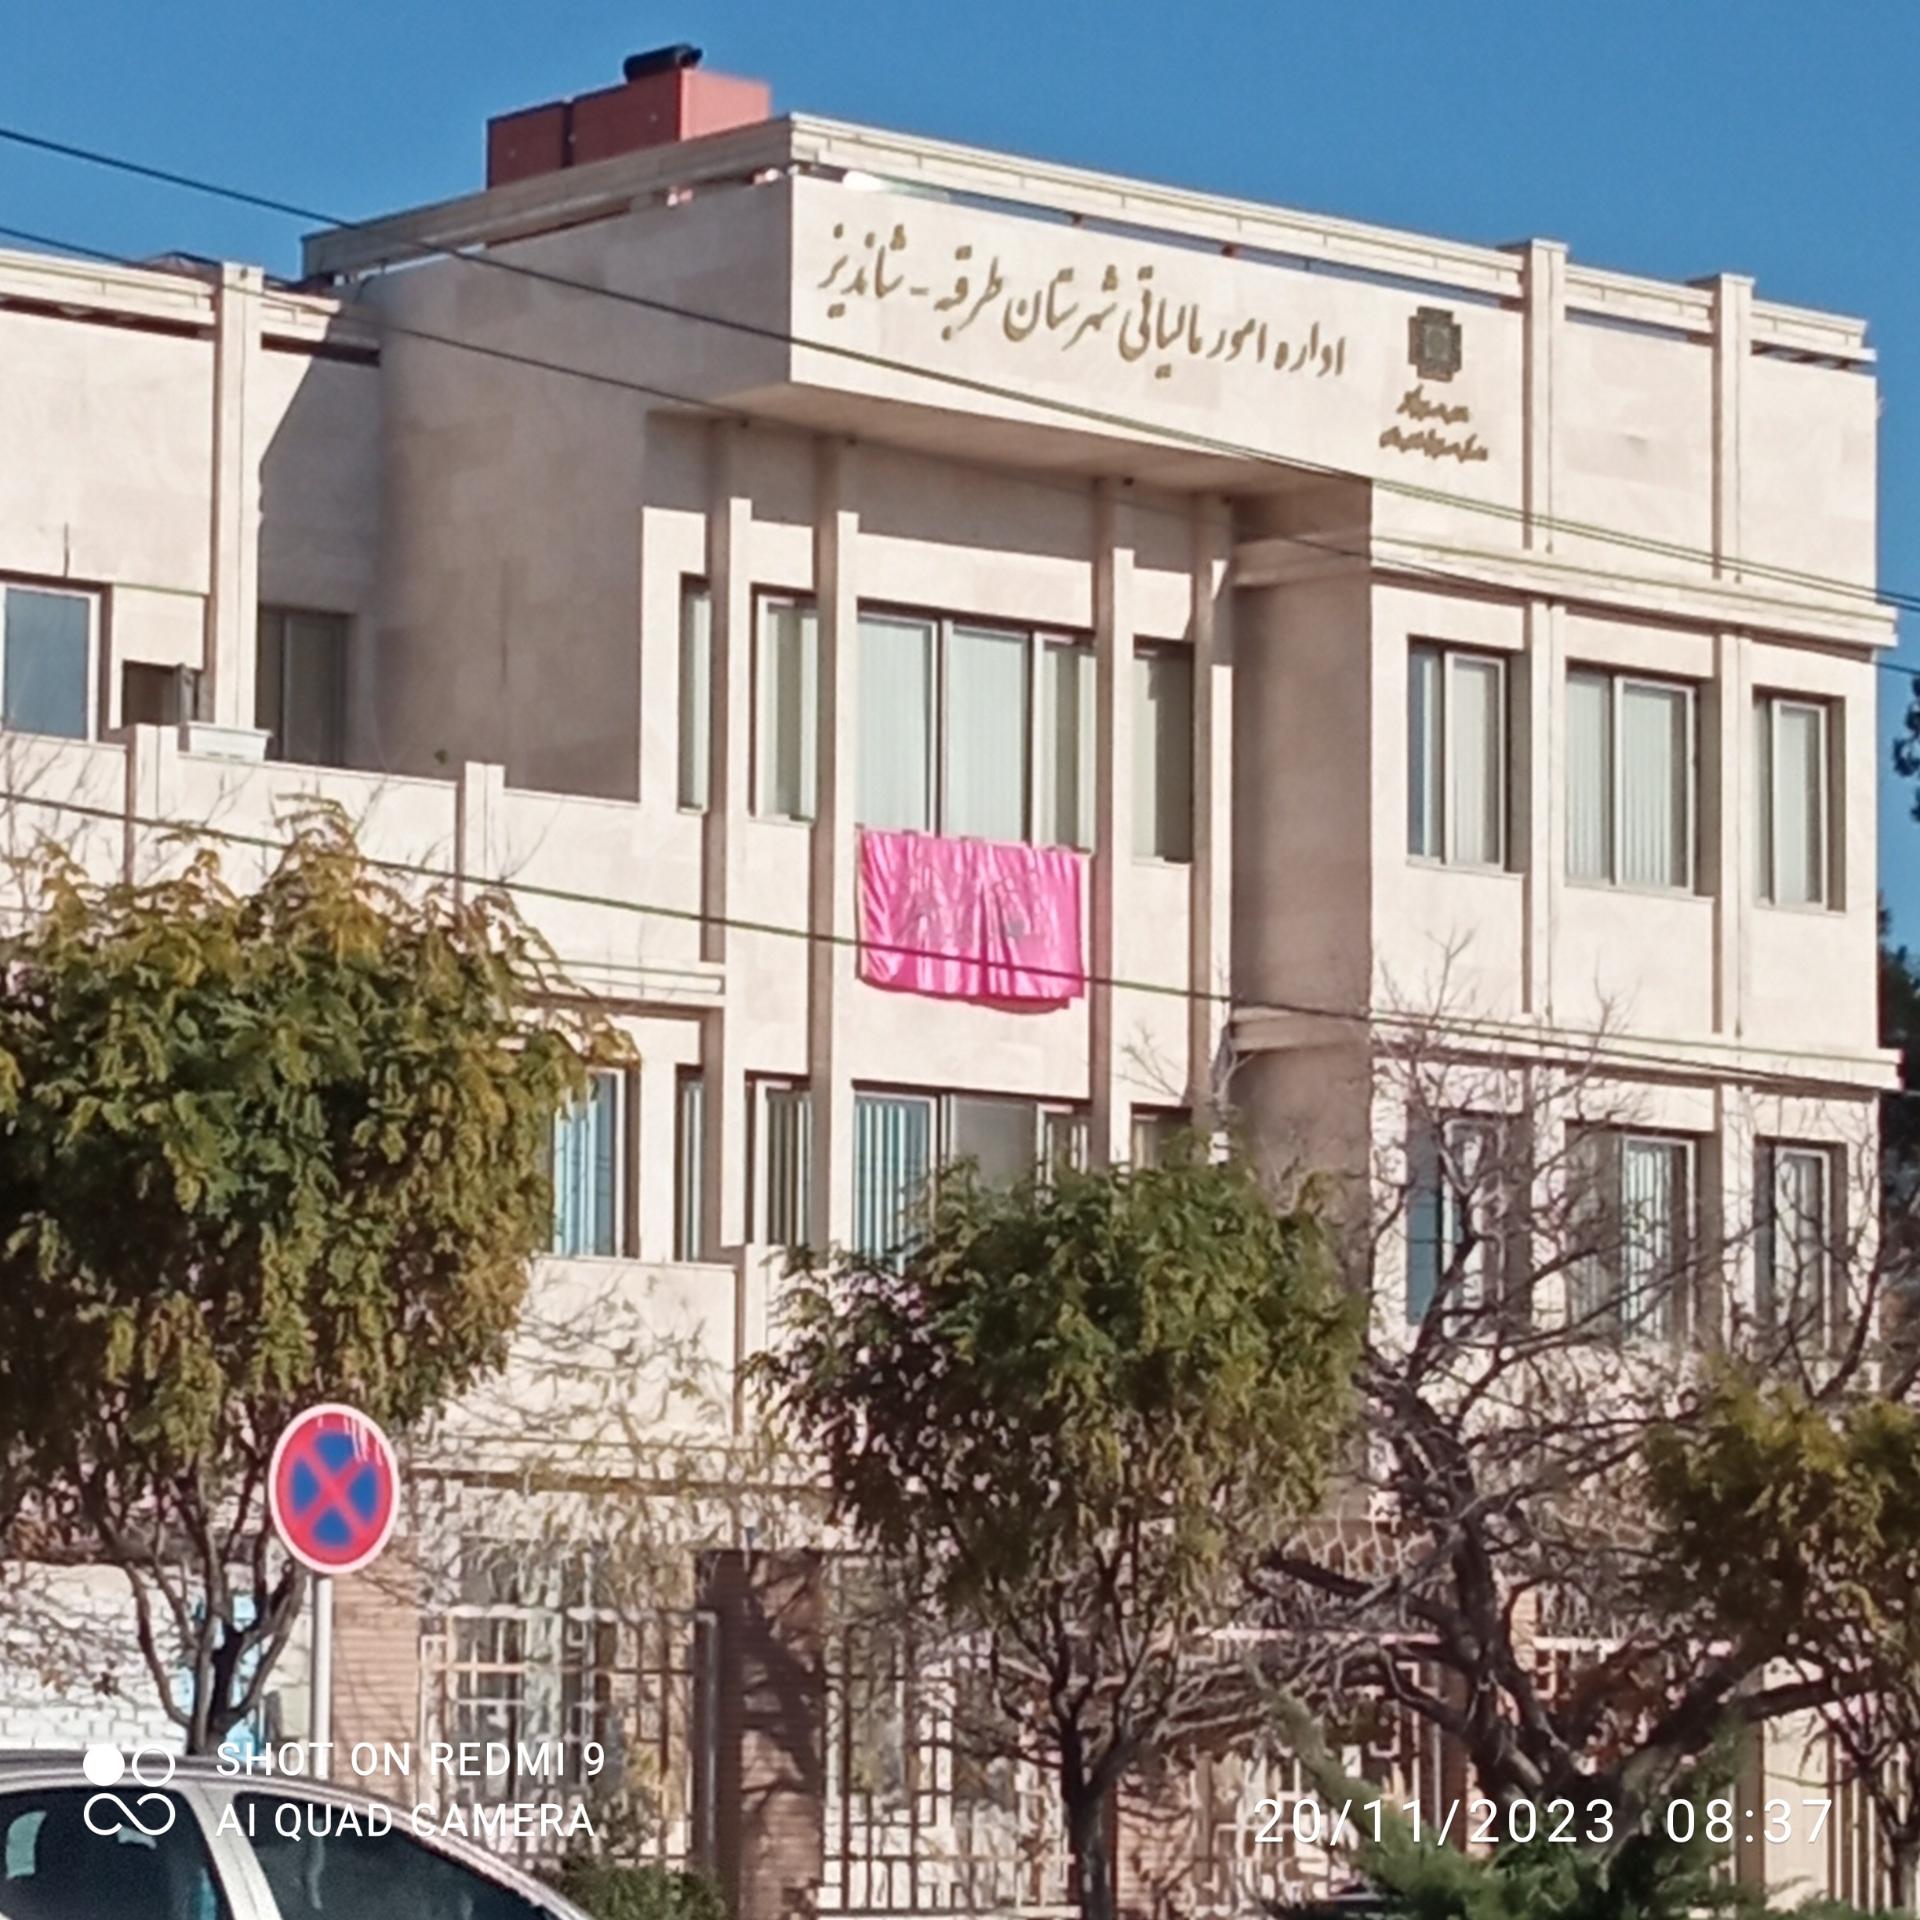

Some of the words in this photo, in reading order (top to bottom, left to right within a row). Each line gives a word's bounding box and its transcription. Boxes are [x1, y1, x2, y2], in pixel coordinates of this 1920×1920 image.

[817, 223, 907, 319] شاندیز
[933, 245, 1004, 342] طرقبه
[1002, 264, 1119, 351] شهرستان
[1117, 265, 1203, 380] مالیاتی
[1206, 318, 1268, 363] امور
[1273, 322, 1346, 378] اداره
